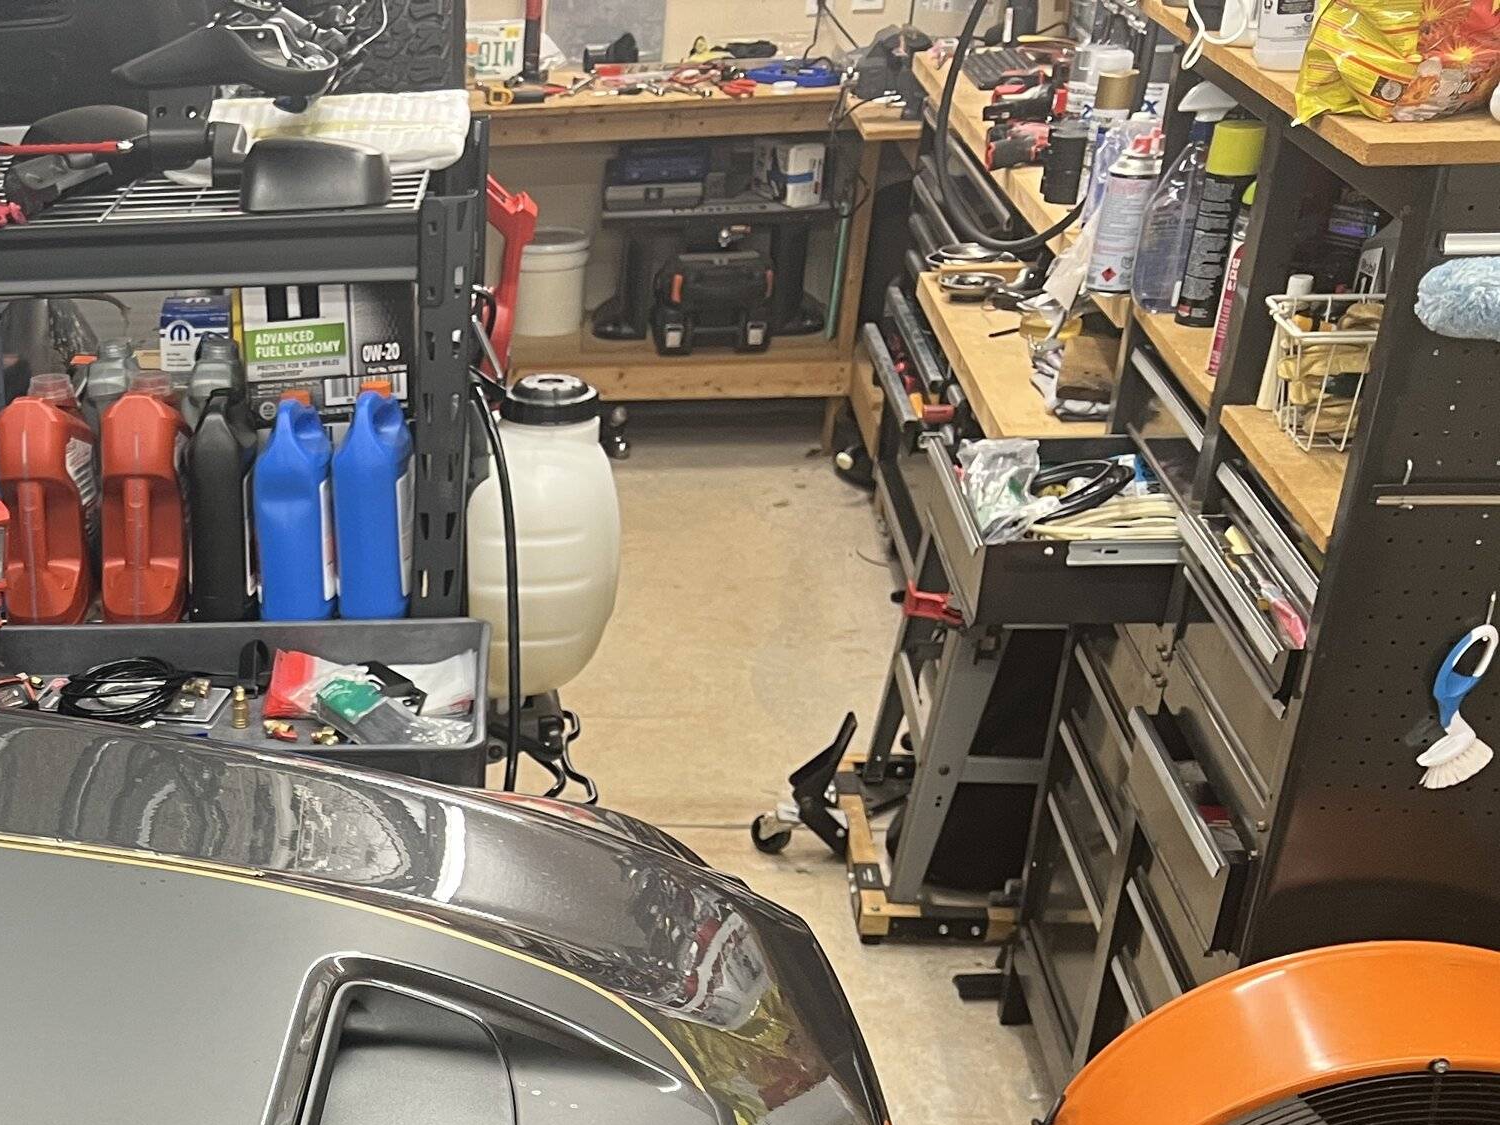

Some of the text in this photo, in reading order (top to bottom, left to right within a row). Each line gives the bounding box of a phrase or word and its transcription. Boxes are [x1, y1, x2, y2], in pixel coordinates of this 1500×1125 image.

[254, 330, 315, 346] ADVANCED
[255, 340, 341, 358] FUEL ECONOMY
[361, 342, 401, 363] 0W-20
